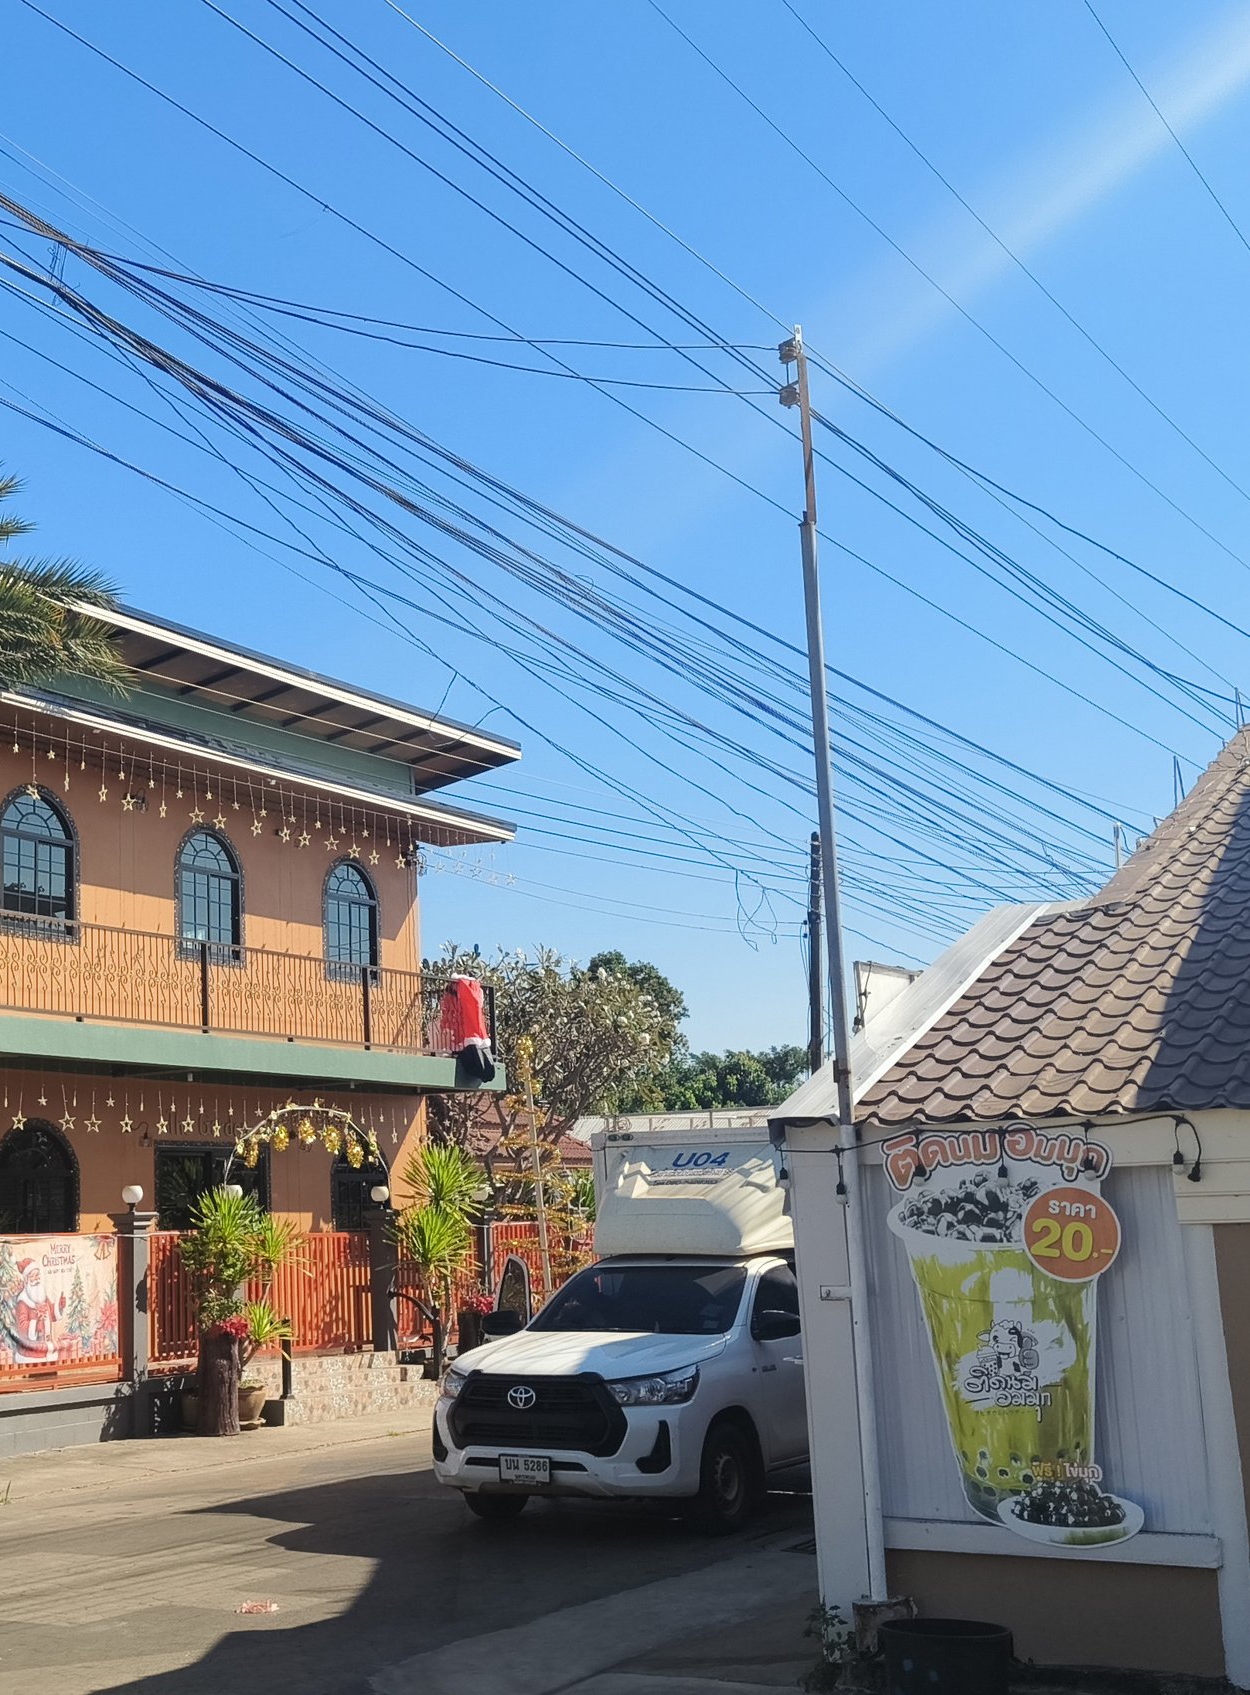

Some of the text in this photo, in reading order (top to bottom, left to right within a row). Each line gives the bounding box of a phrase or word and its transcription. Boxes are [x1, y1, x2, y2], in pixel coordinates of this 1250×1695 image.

[884, 1131, 999, 1188] ติดนม
[1048, 1200, 1096, 1219] ราคา
[50, 1243, 71, 1255] MERRY
[42, 1254, 76, 1268] CHRISTMAS
[523, 1459, 549, 1472] 5286
[1063, 1462, 1100, 1484] ไข่มุก
